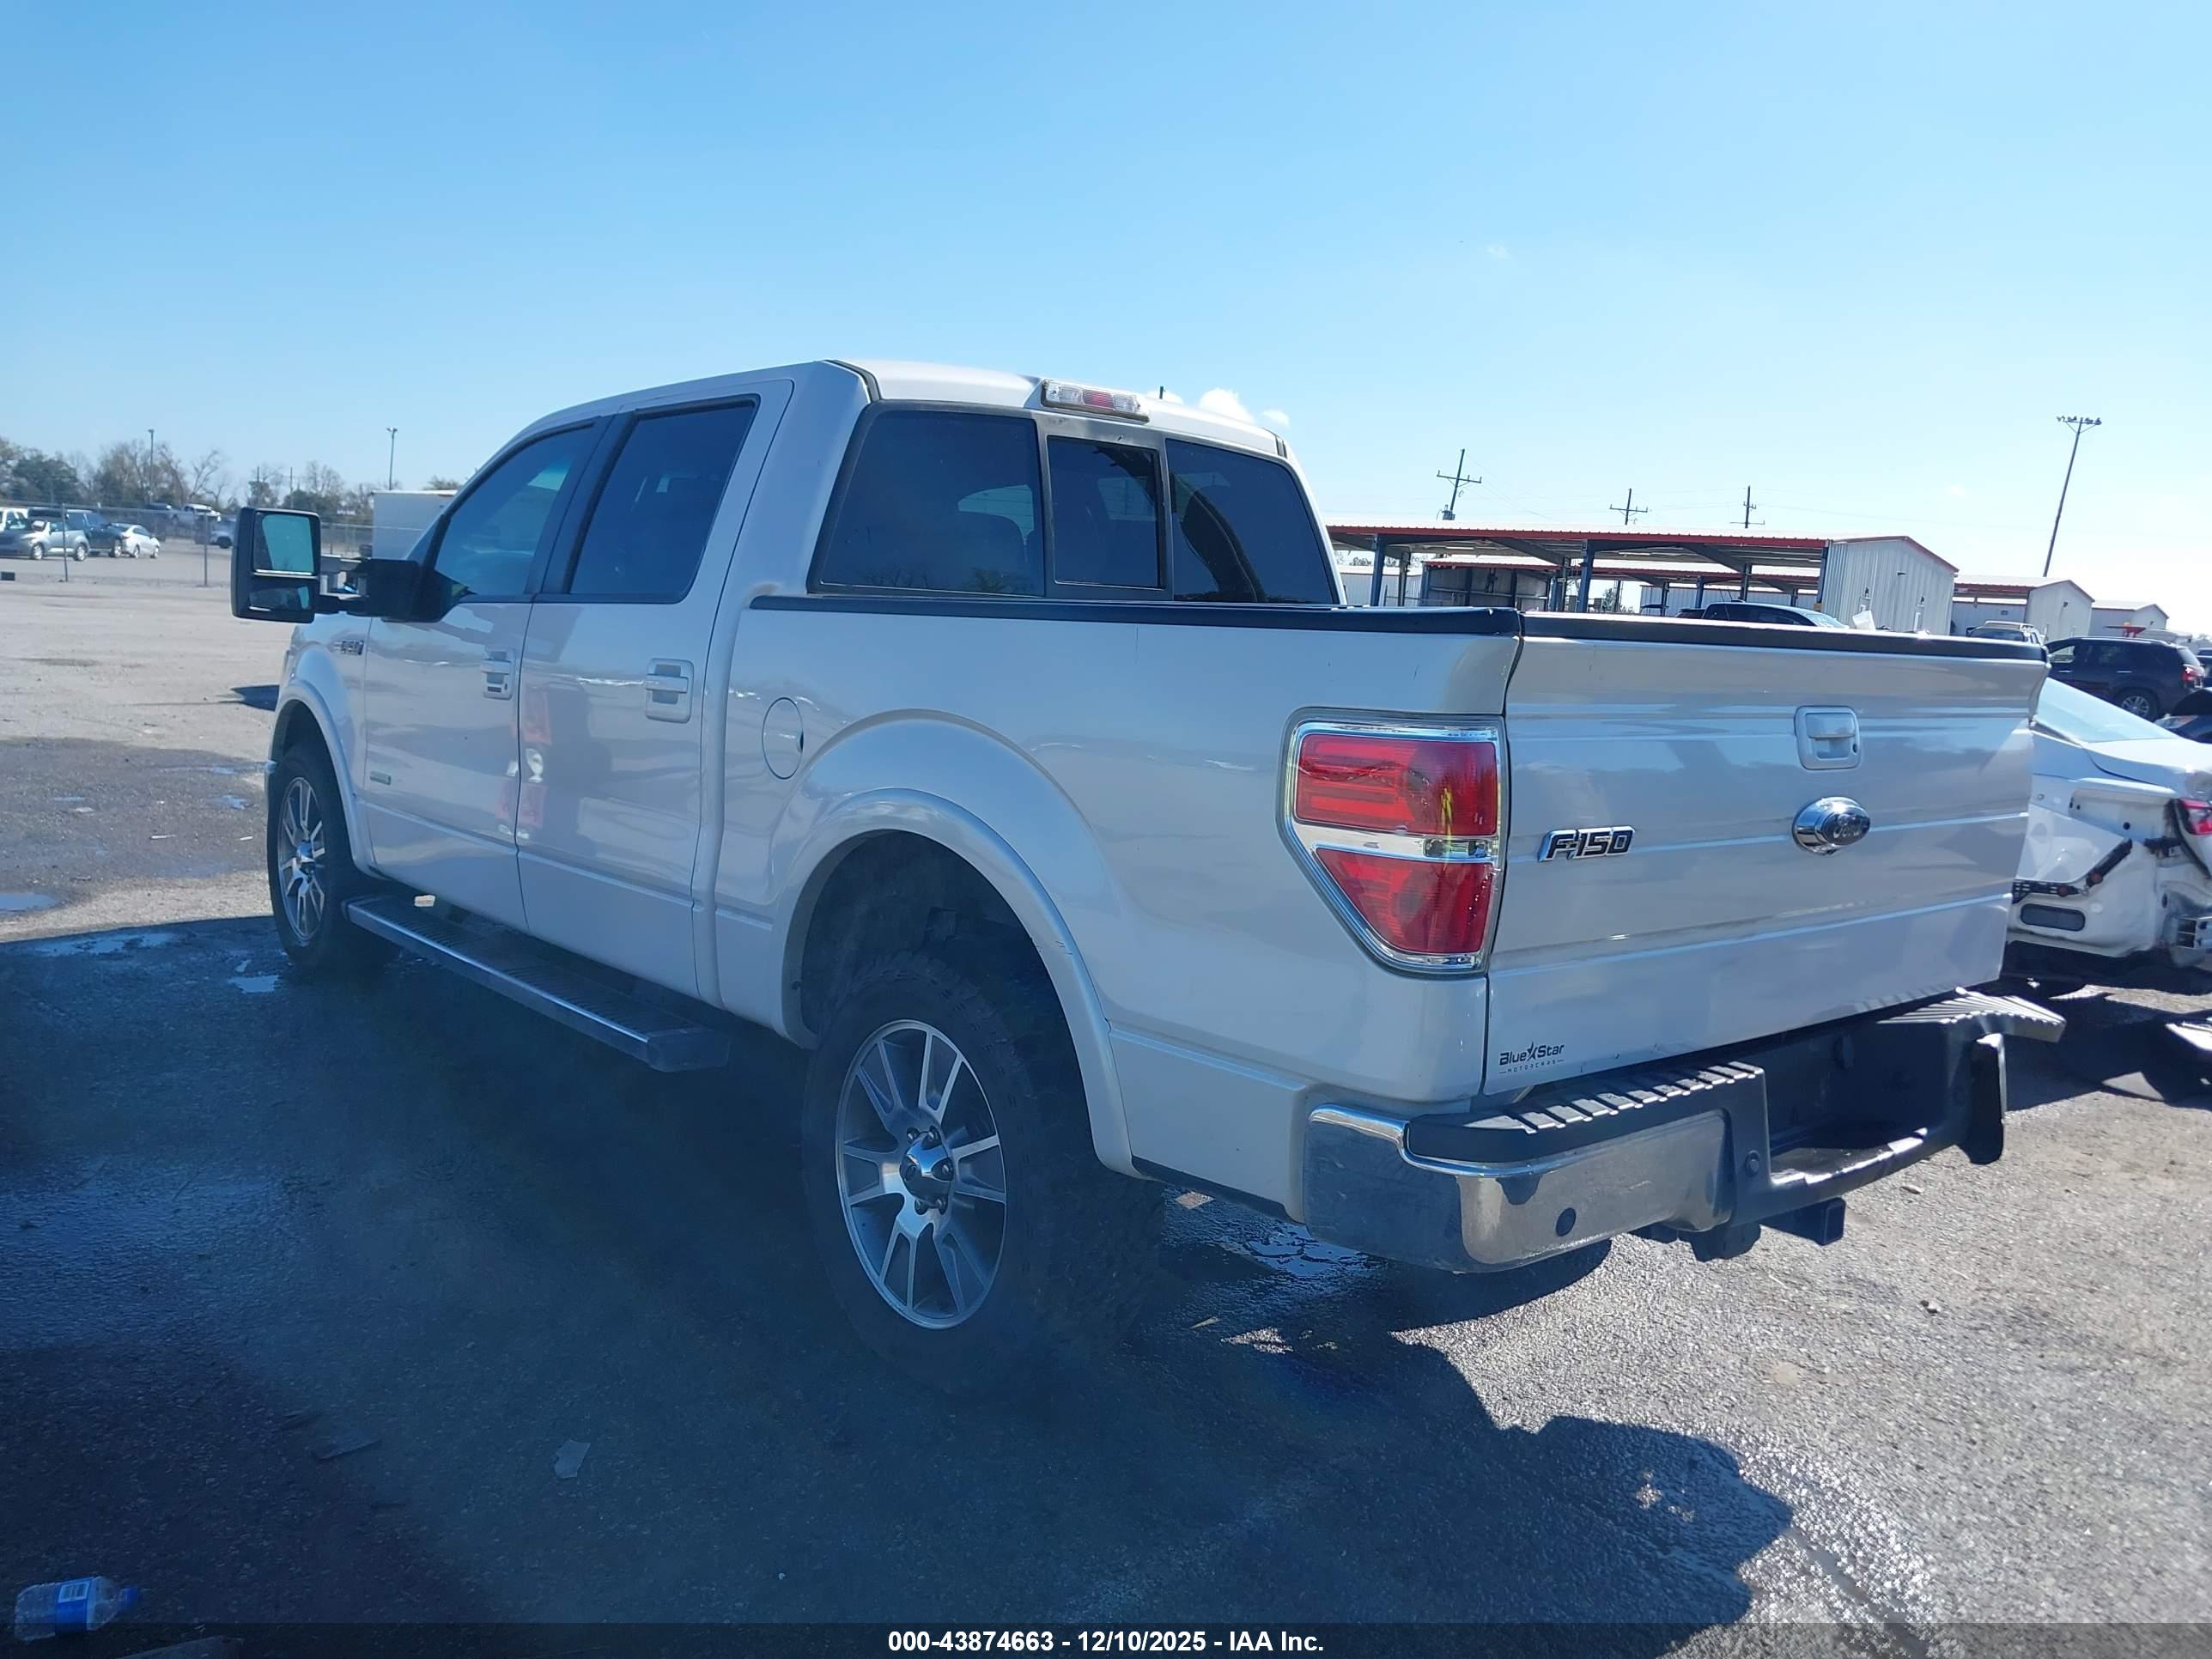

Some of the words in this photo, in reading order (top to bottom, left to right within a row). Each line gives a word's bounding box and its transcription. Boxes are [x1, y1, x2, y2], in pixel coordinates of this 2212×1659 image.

[1537, 826, 1635, 862] F-150
[1499, 1050, 1528, 1066] Blue
[1536, 1043, 1565, 1059] Star
